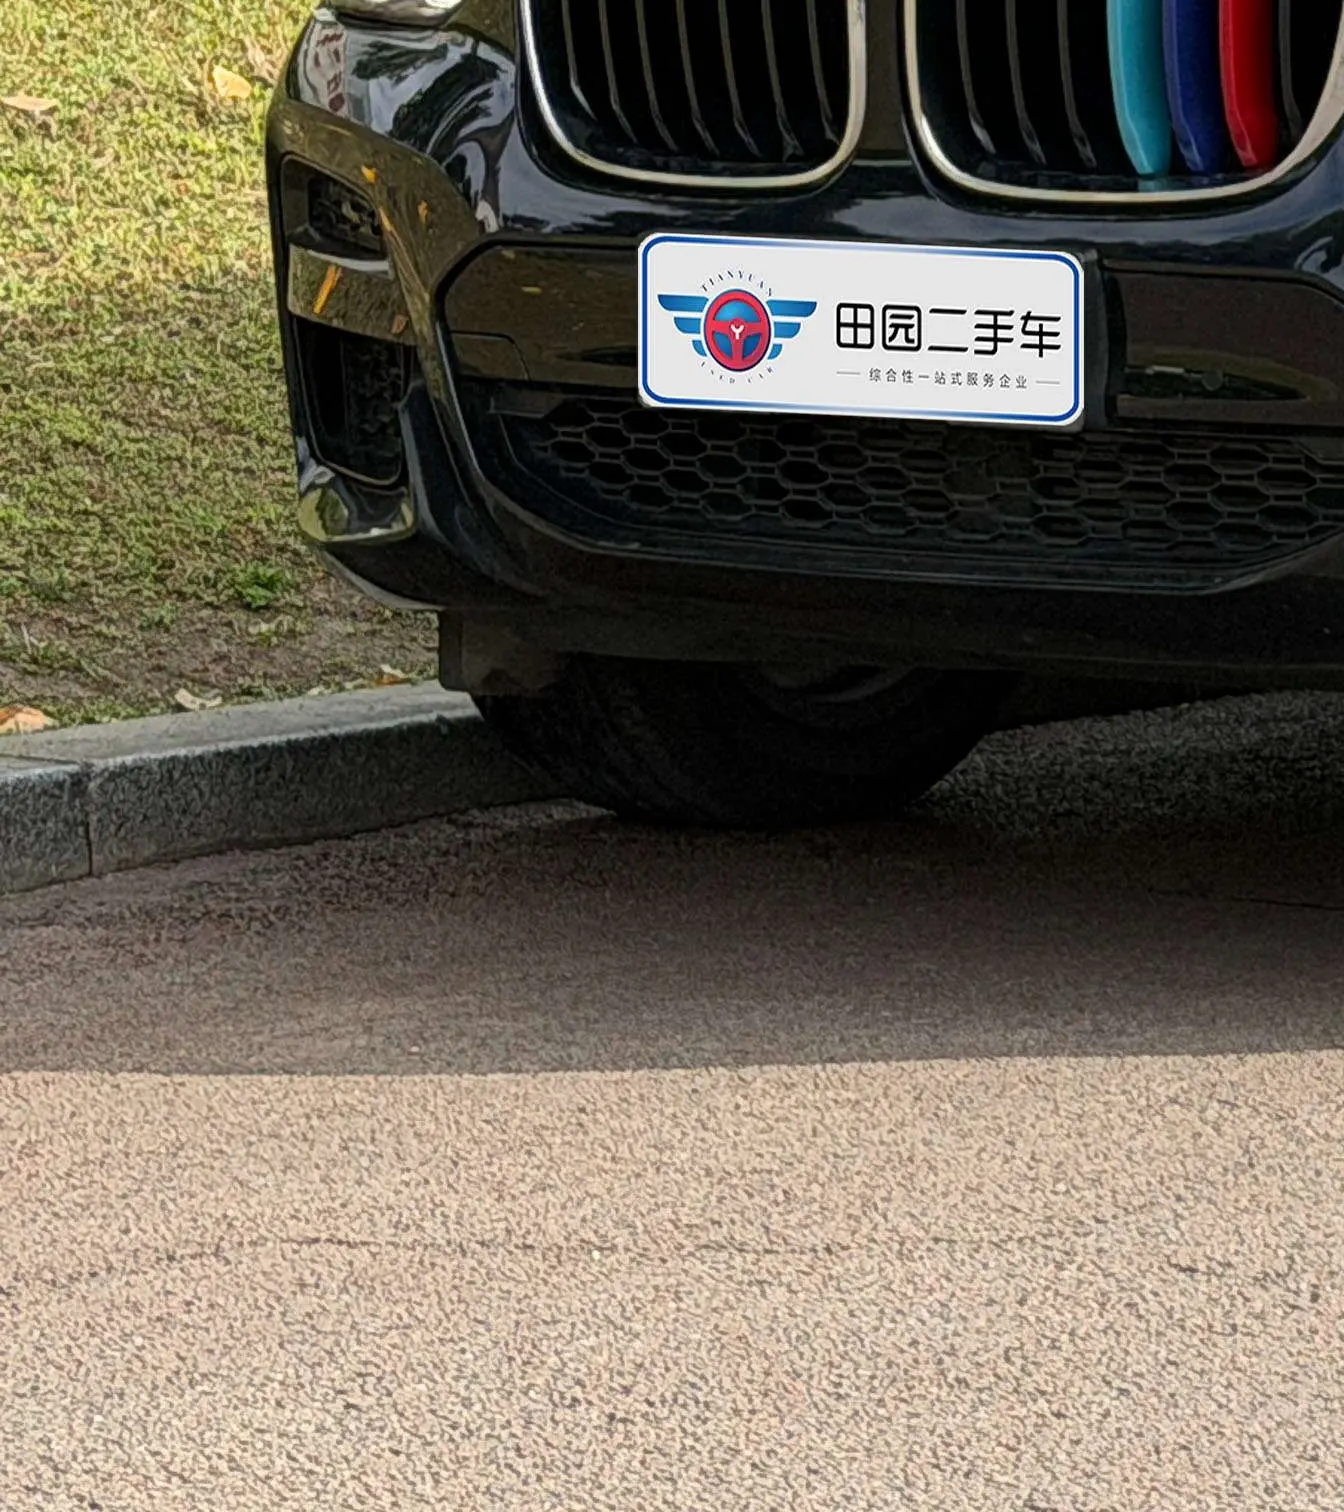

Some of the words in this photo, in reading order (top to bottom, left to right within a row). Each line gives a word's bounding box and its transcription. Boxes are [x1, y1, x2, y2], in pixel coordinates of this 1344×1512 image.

[836, 302, 1062, 359] 田园二手车
[868, 367, 1029, 390] 综合性一站式服务企业
